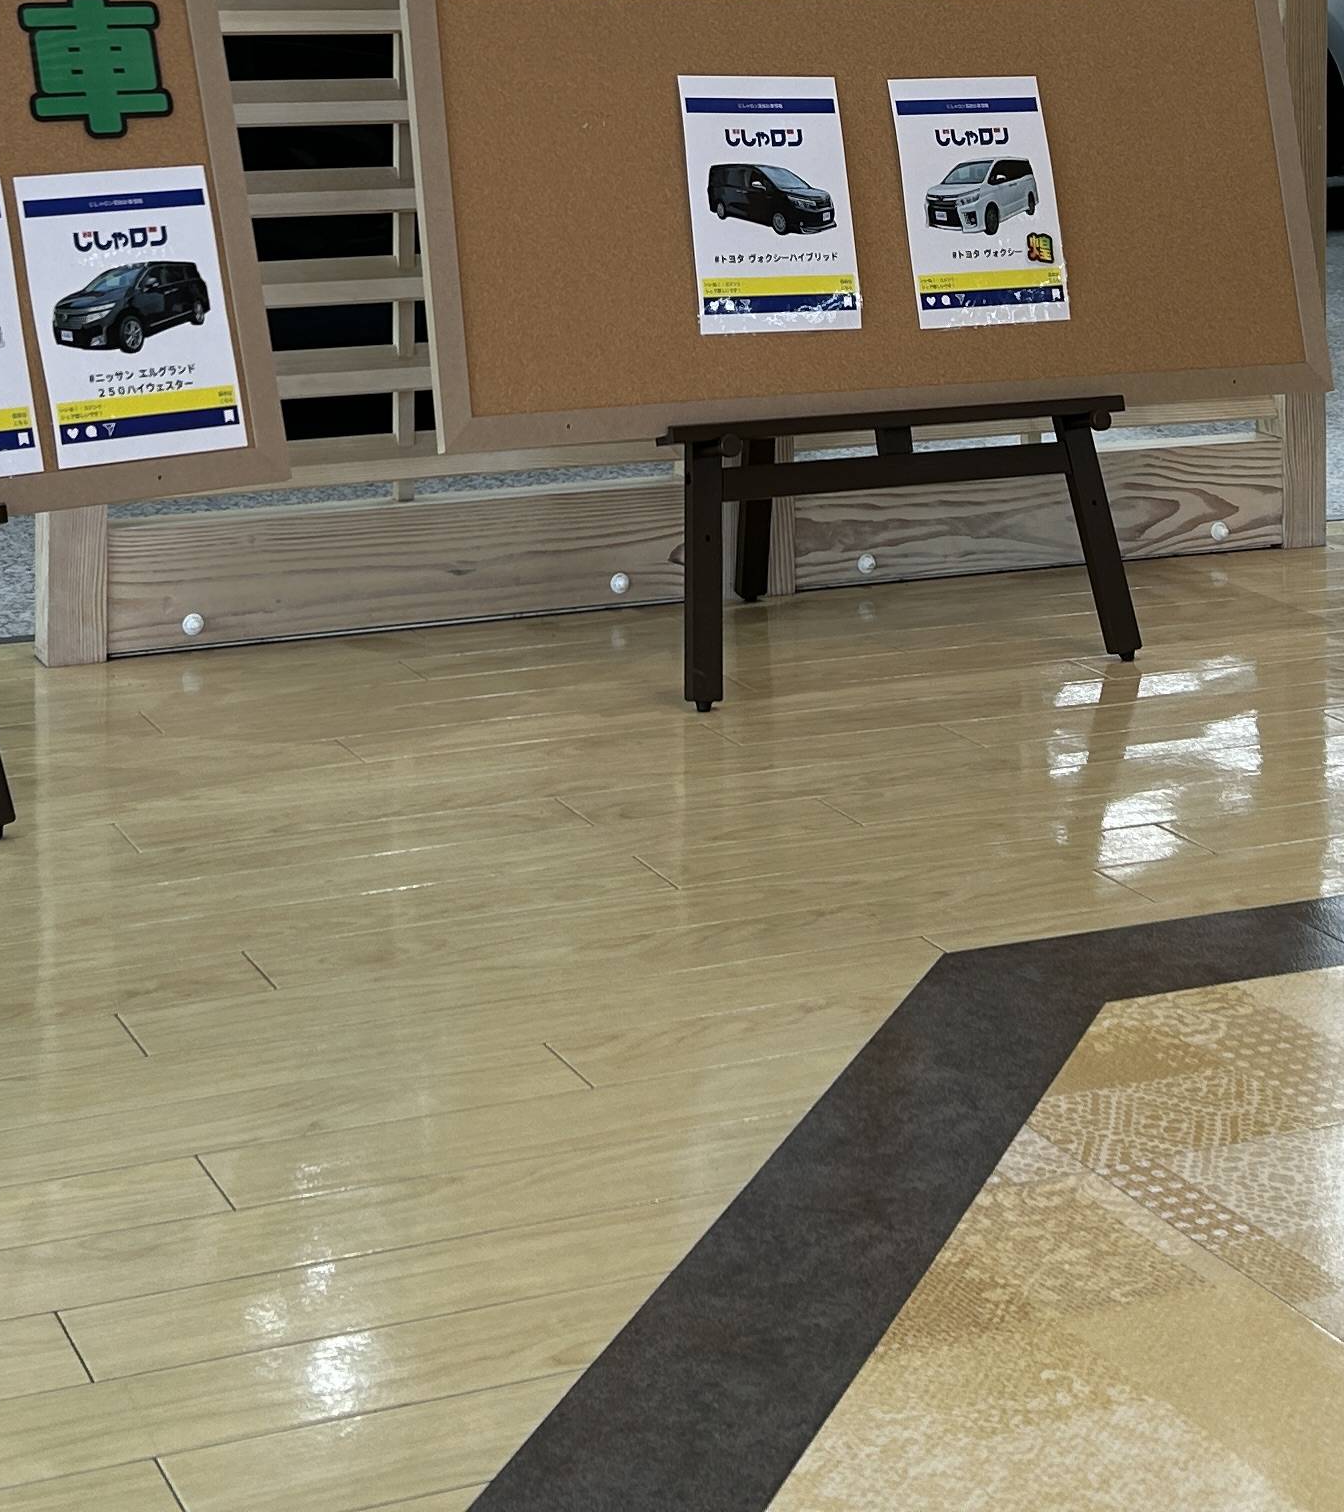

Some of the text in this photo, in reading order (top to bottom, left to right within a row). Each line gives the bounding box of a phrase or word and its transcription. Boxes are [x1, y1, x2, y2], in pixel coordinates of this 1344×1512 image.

[724, 127, 803, 148] じしゃロン
[934, 127, 1009, 148] じしゃロン
[73, 225, 168, 253] じしゃロン
[139, 363, 196, 378] エルグランド
